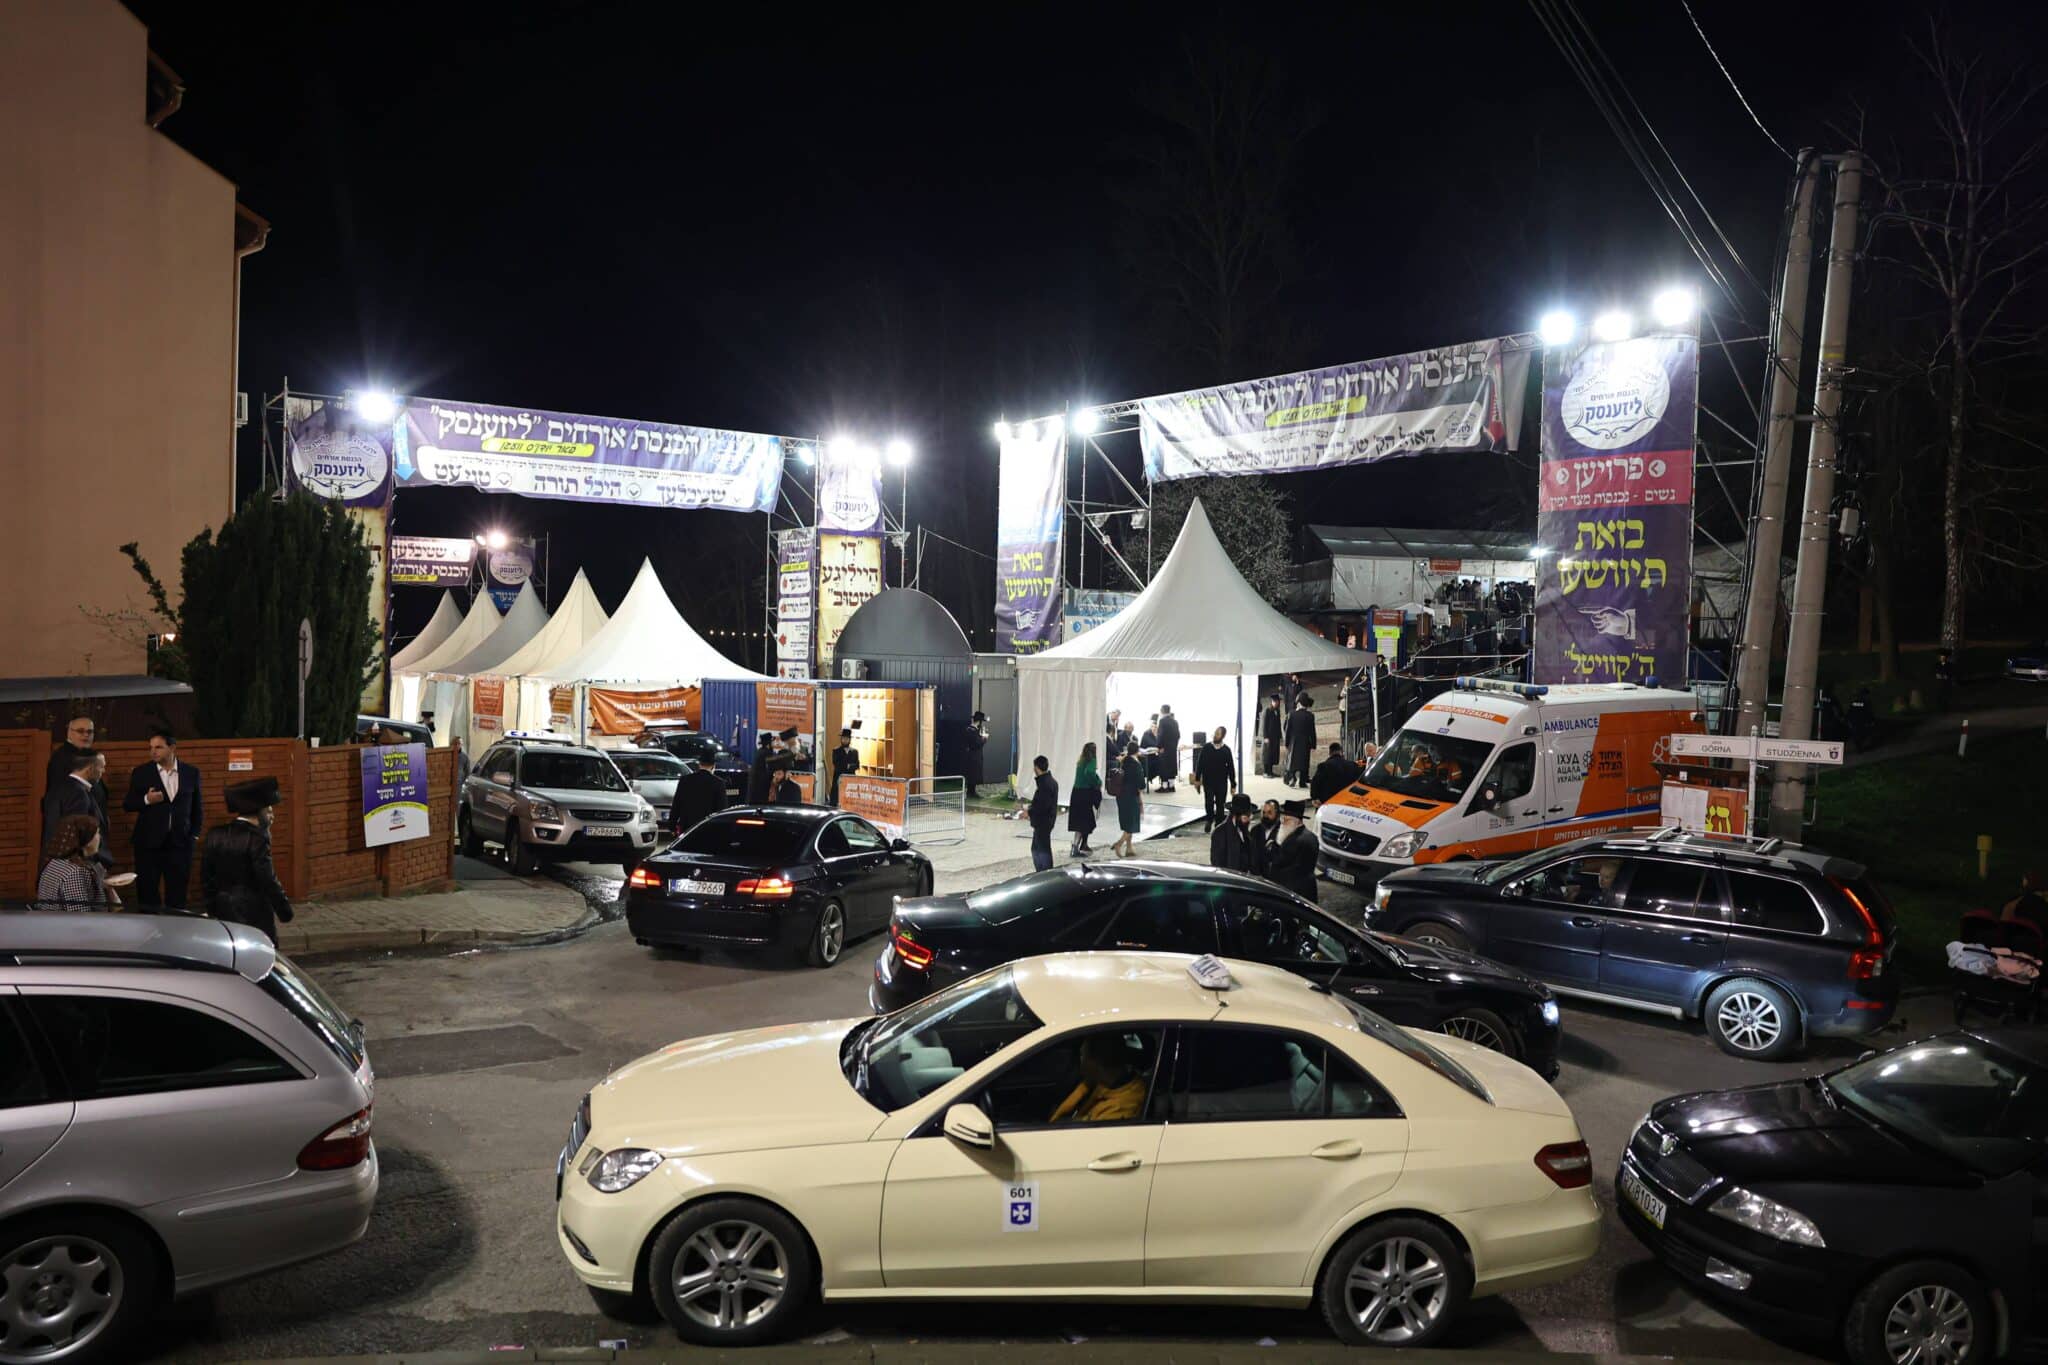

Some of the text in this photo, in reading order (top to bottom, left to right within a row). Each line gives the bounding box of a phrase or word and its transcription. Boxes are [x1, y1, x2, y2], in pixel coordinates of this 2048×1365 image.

[1406, 351, 1487, 391] הכנסת
[1320, 366, 1399, 402] אורחים
[1585, 397, 1642, 424] ליזענסק
[547, 420, 626, 448] אורחים
[631, 427, 700, 456] הכנסת
[313, 463, 365, 477] ליזענסק
[1573, 456, 1644, 492] פרויען
[534, 474, 621, 496] היכל תורה
[1595, 491, 1630, 504] נכנסות
[1645, 488, 1676, 502] נשים
[431, 565, 469, 577] הכנסת
[1557, 558, 1667, 596] תיוושעו
[1544, 717, 1600, 732] AMBULANCE
[1701, 744, 1732, 754] GÓRNA
[1766, 748, 1822, 759] STUDZIENNA
[1557, 753, 1580, 765] ІХУД
[1553, 830, 1580, 841] UNITED
[1010, 1187, 1032, 1199] 601
